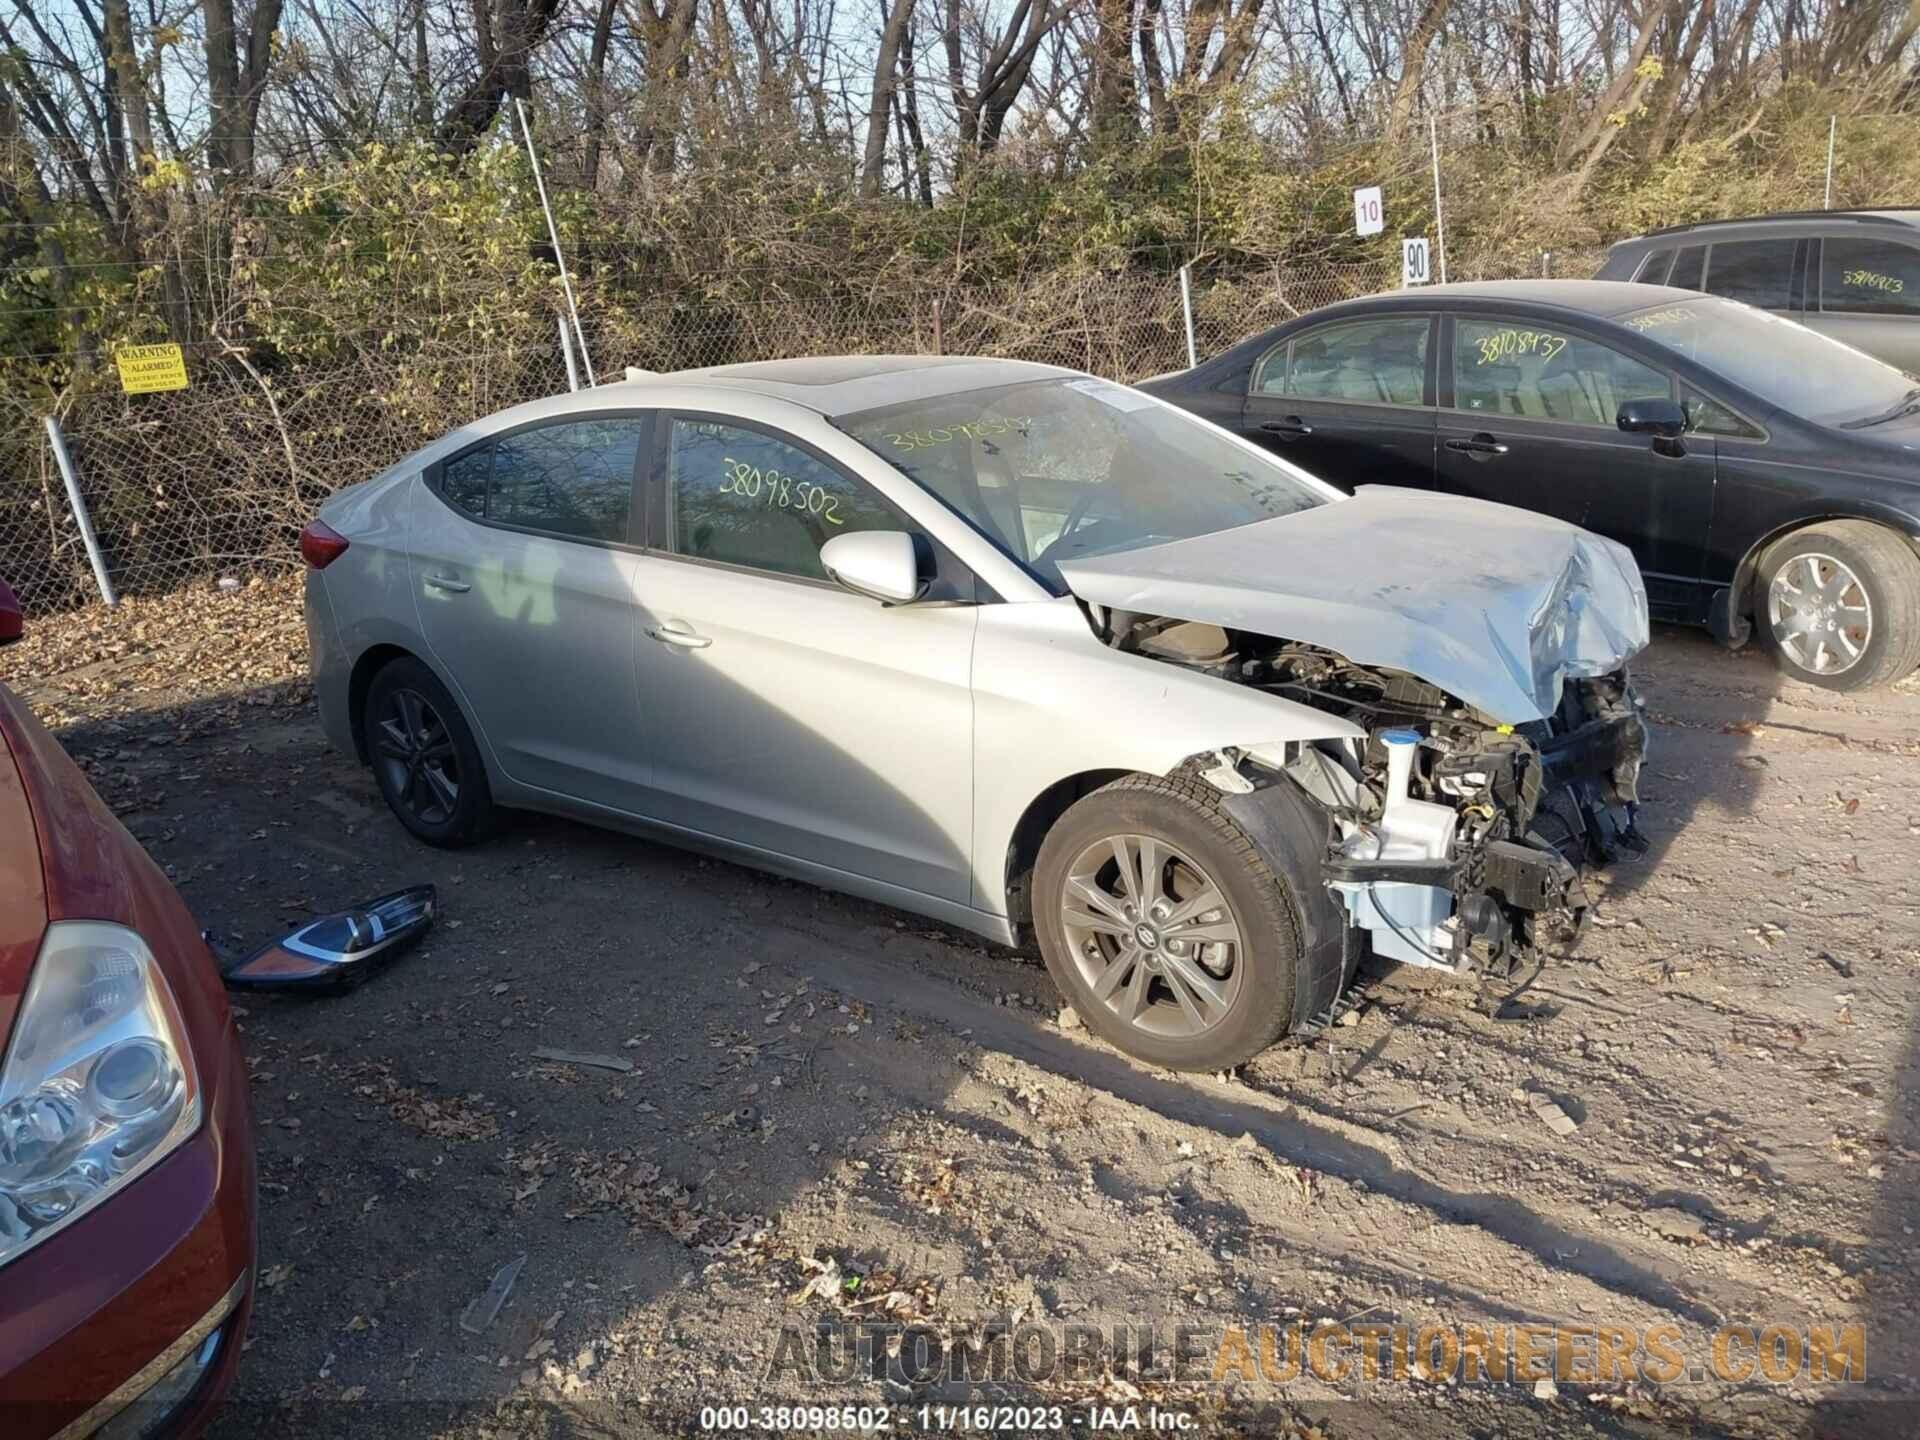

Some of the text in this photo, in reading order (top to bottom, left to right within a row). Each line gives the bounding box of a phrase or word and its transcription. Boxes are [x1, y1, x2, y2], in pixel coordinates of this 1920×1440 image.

[1360, 201, 1379, 222] 10
[1407, 243, 1425, 278] 90
[119, 346, 176, 359] WARNING
[131, 361, 173, 372] ALARMED
[719, 457, 844, 525] 38098502
